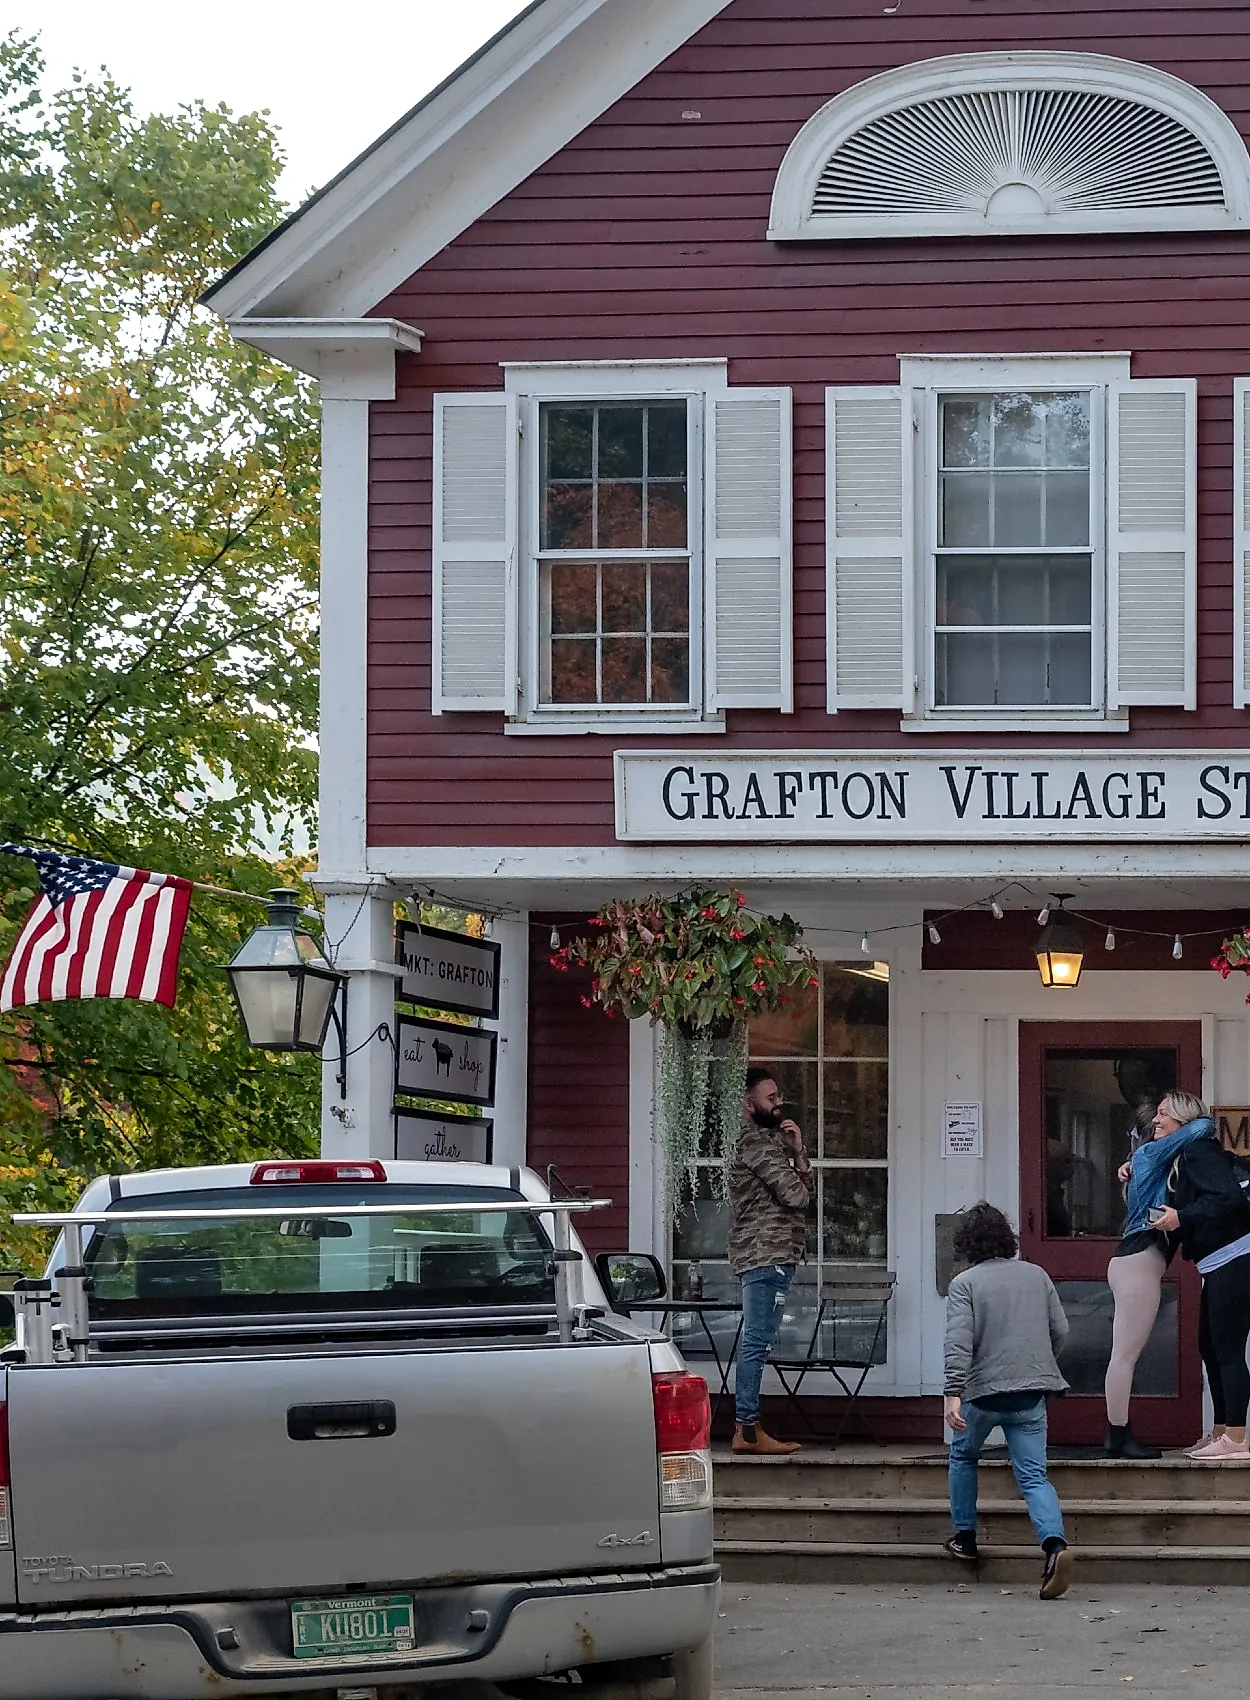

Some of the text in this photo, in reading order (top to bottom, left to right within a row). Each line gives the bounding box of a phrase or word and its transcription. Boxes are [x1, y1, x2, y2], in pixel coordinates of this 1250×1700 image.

[662, 765, 910, 820] GRAFTON
[938, 765, 1166, 820] VILLAGE
[402, 952, 493, 988] MKT: GRAFTON
[404, 1036, 484, 1092] eat shop
[424, 1125, 460, 1161] gather
[597, 1530, 654, 1548] 4x4
[22, 1555, 75, 1566] TOYOTA
[23, 1560, 175, 1585] TUNDRA
[328, 1598, 377, 1609] Vermont
